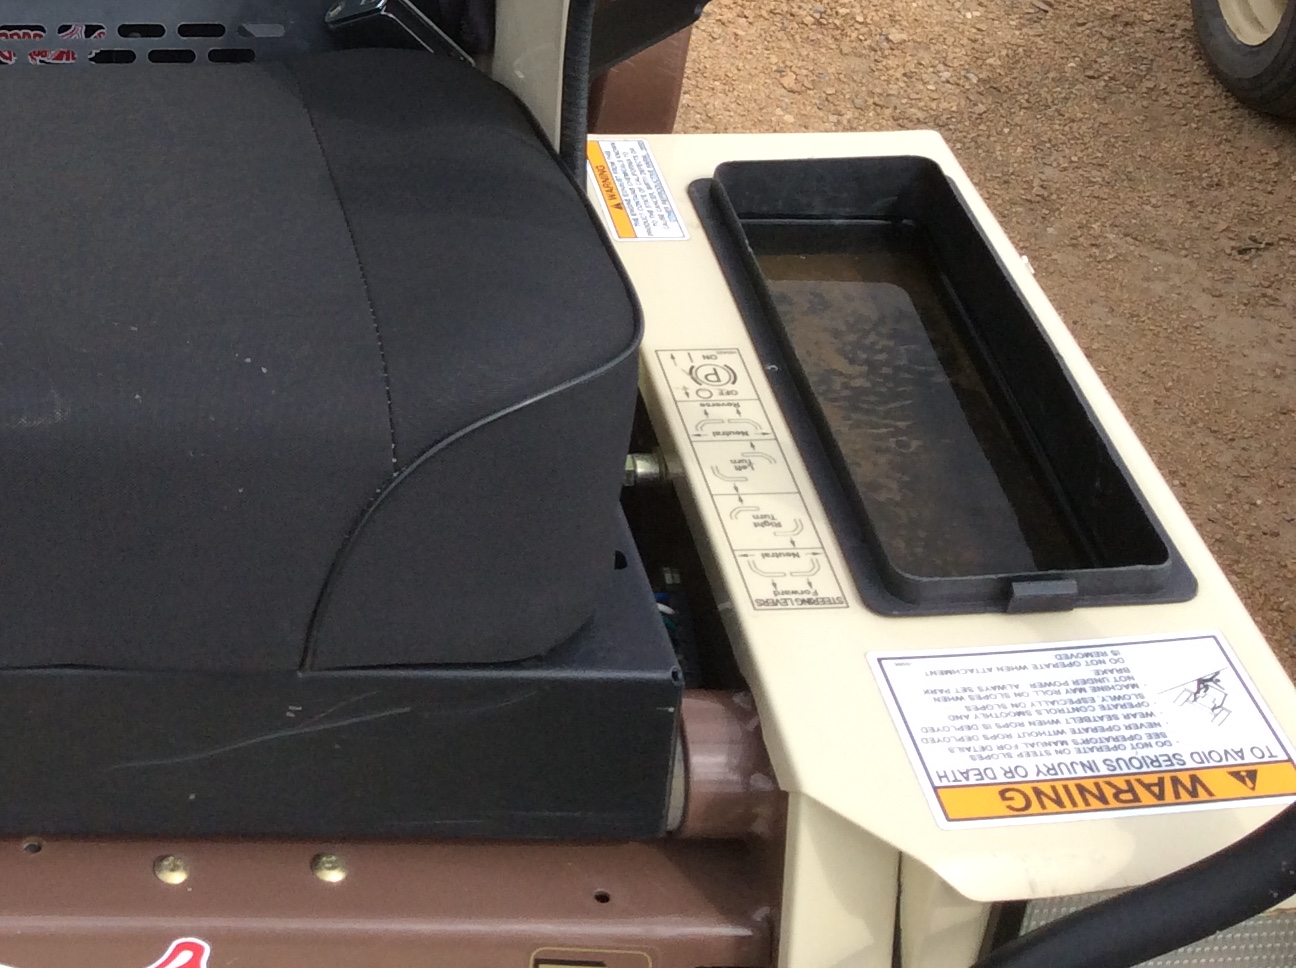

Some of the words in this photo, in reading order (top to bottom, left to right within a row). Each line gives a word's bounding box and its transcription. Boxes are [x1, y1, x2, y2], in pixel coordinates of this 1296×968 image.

[753, 520, 782, 528] Right
[754, 598, 794, 607] LEVERS
[794, 596, 844, 605] STEERING
[1031, 661, 1081, 670] OPERATE
[925, 667, 992, 676] ATTACHMENT
[1071, 677, 1110, 686] UNDER
[1113, 675, 1135, 683] NOT
[977, 684, 1019, 692] ALWAYS
[1089, 683, 1140, 693] MACHINE
[968, 693, 1010, 701] SLOPES
[1030, 697, 1096, 707] ESPECIALLY
[1098, 701, 1150, 711] OPERATE
[965, 704, 1007, 712] SLOPES
[1035, 705, 1096, 715] CONTROLS
[974, 710, 1032, 720] SMOOTHLY
[1065, 714, 1120, 724] SEATBELT
[1121, 711, 1156, 720] WEAR
[920, 724, 979, 733] DEPLOYED
[995, 721, 1025, 729] ROPS
[1069, 724, 1121, 734] OPERATE
[1123, 722, 1162, 730] NEVER
[1017, 729, 1067, 738] WITHOUT
[1145, 732, 1168, 740] SEE
[921, 735, 979, 744] DEPLOYED
[1021, 740, 1069, 748] MANUAL
[1071, 733, 1143, 746] OPERATOR'S
[1155, 740, 1172, 748] DO
[1074, 744, 1126, 754] OPERATE
[1130, 742, 1153, 750] NOT
[969, 752, 1013, 761] SLOPES
[1017, 750, 1052, 758] STEEP
[1189, 747, 1245, 764] AVOID
[1250, 745, 1278, 759] TO
[1102, 753, 1186, 772] SERIOUS
[999, 765, 1028, 780] OR
[1035, 759, 1100, 777] INJURY
[936, 767, 997, 783] DEATH
[998, 774, 1216, 812] WARNING
